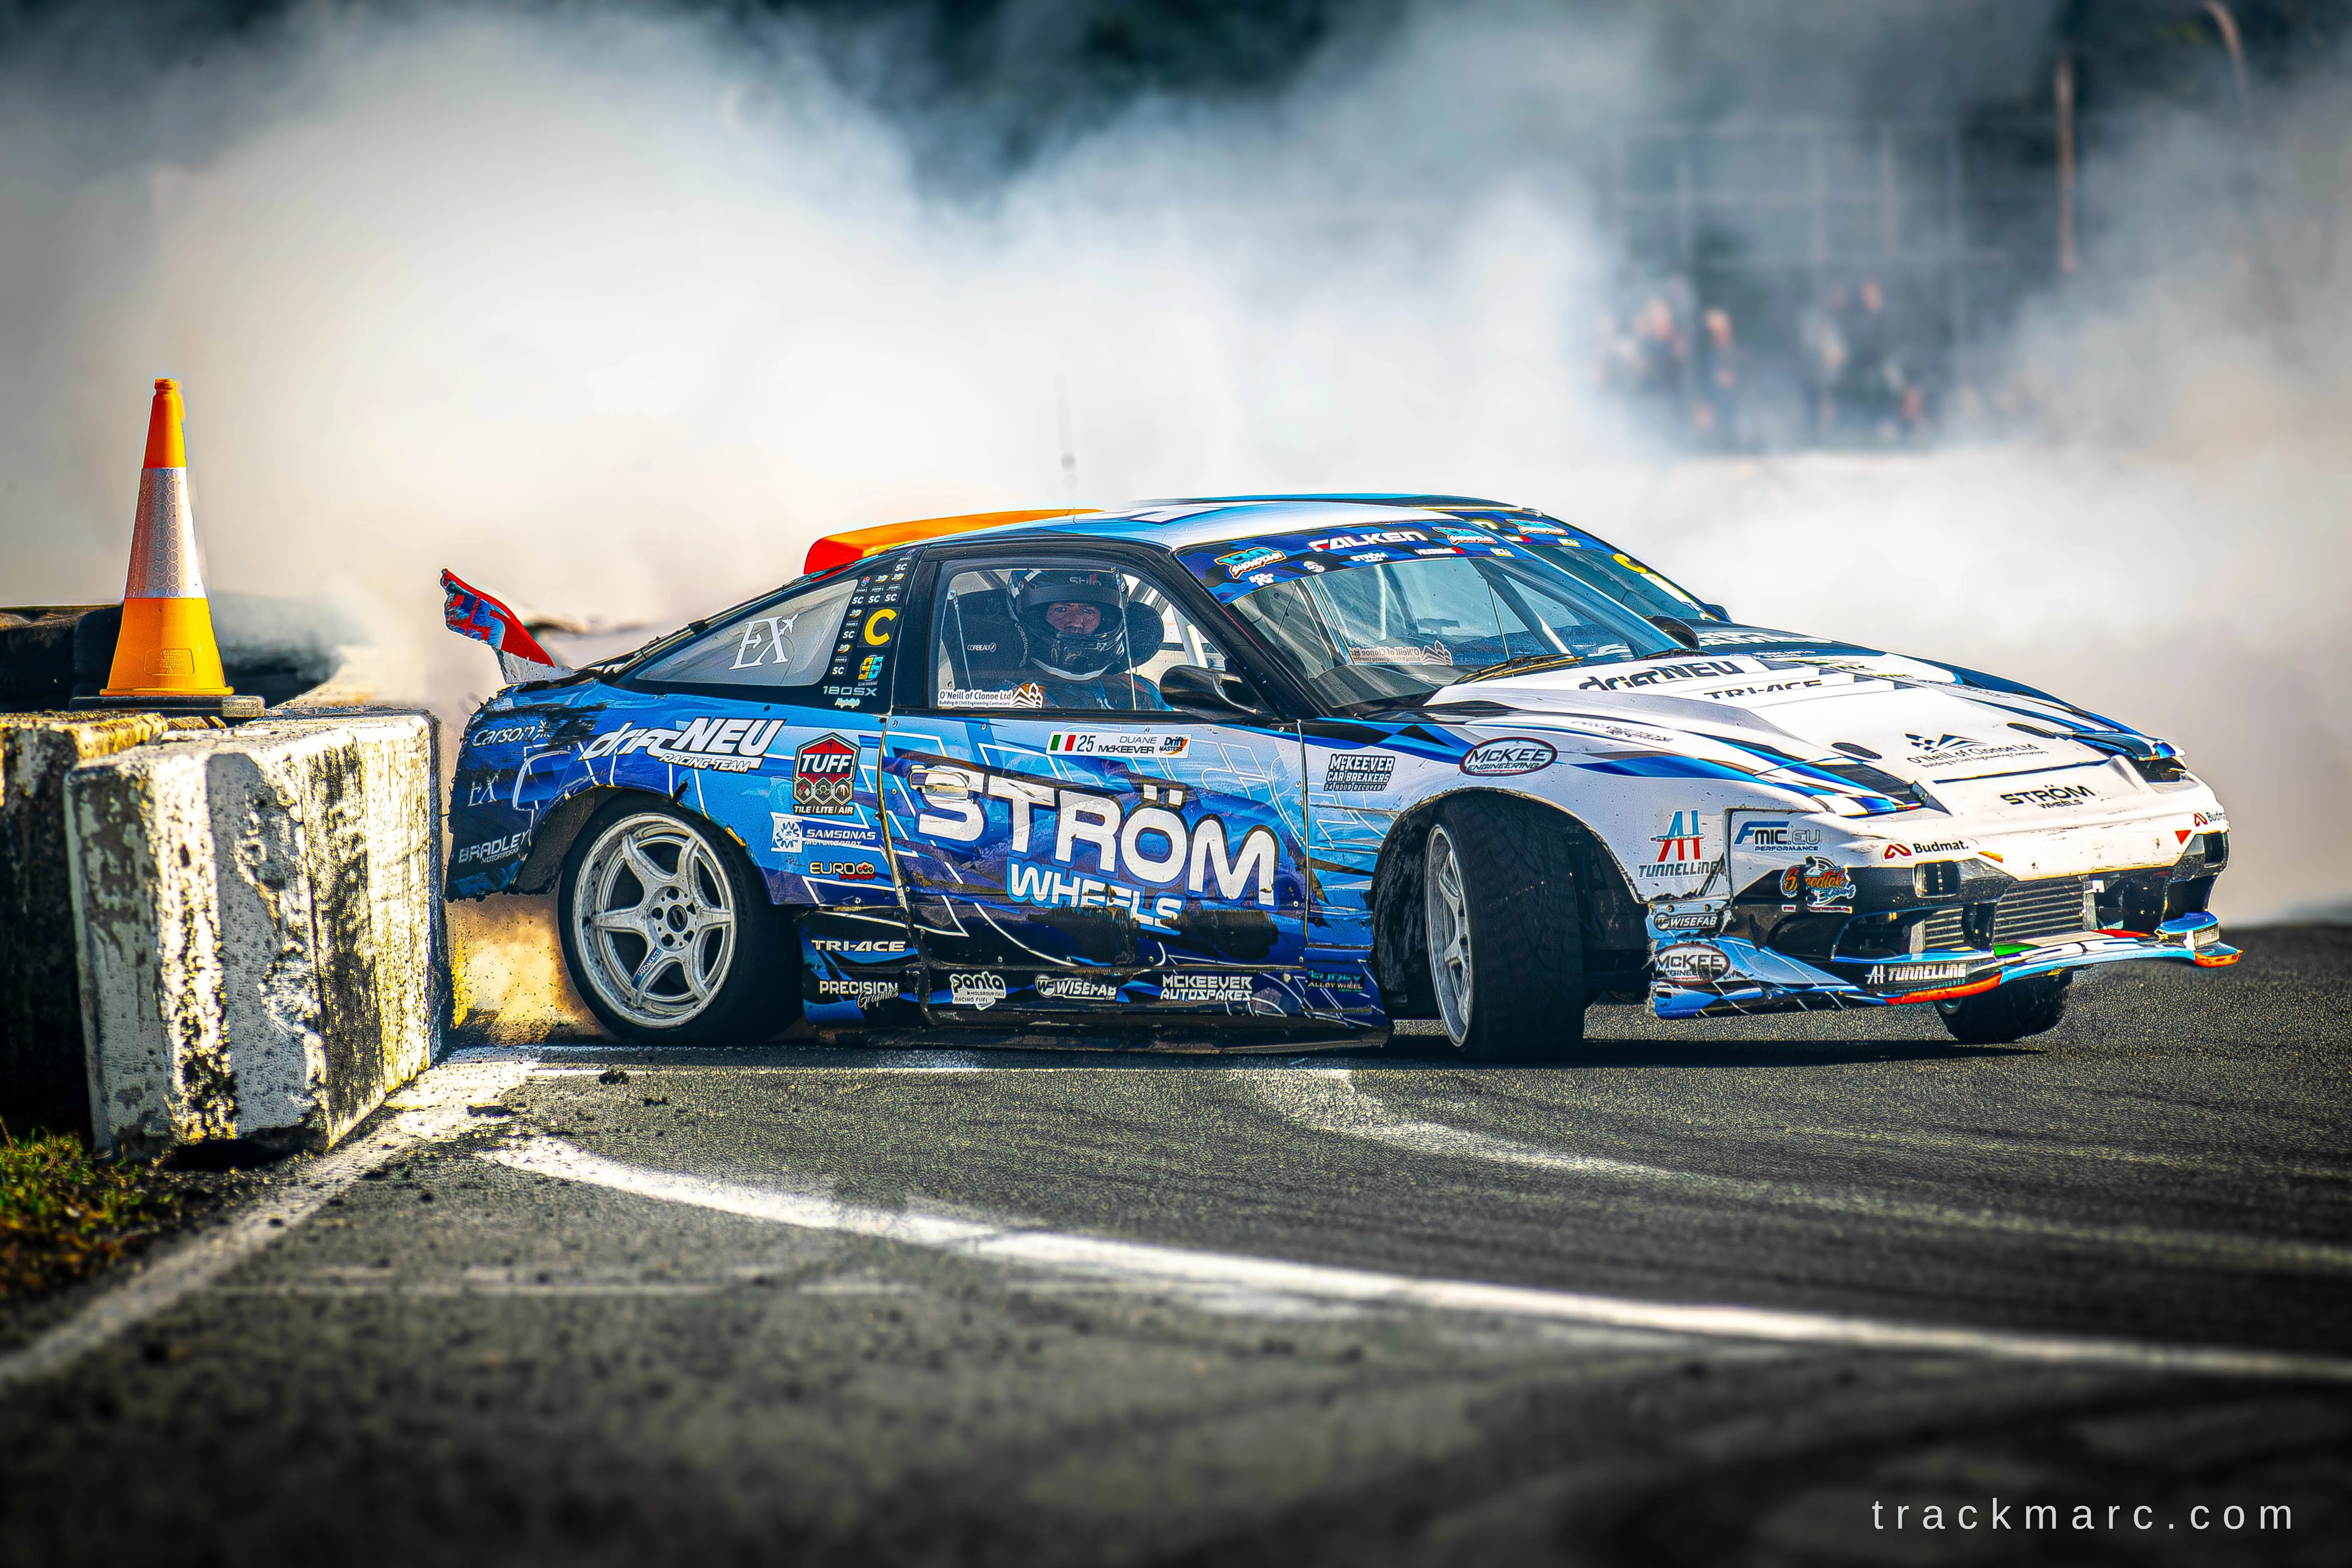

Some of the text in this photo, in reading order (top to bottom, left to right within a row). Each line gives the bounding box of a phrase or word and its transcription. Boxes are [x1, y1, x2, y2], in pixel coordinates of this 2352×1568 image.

[1307, 531, 1428, 553] FALKEN
[864, 609, 897, 646] C
[823, 686, 877, 696] 180SX
[940, 691, 964, 700] O'Neill
[965, 691, 973, 700] of
[974, 692, 998, 700] Clonoe
[472, 725, 536, 747] Carson
[1076, 735, 1096, 752] 25
[1164, 737, 1184, 746] Drift
[658, 753, 751, 772] RACING TEAM
[800, 754, 852, 773] TUFF
[1466, 762, 1540, 771] ENGINEERING
[1327, 771, 1391, 783] CAR BREAKERS
[2000, 785, 2097, 805] STRÖM
[2037, 799, 2084, 809] WHEELS
[806, 829, 876, 840] SAMSONAS
[910, 764, 1276, 907] STRÖM
[458, 829, 530, 864] BRADLEY
[809, 862, 855, 874] EURO
[1011, 862, 1184, 930] WHEELS
[1670, 916, 1718, 927] WISEFAB
[811, 940, 906, 952] TRI-ACE
[1888, 963, 1967, 982] TUNNELLING
[819, 980, 898, 994] PRECISION
[1162, 974, 1253, 989] MCKEEVER
[857, 988, 899, 1010] Graphics
[1160, 988, 1253, 1002] AUTOSPARES
